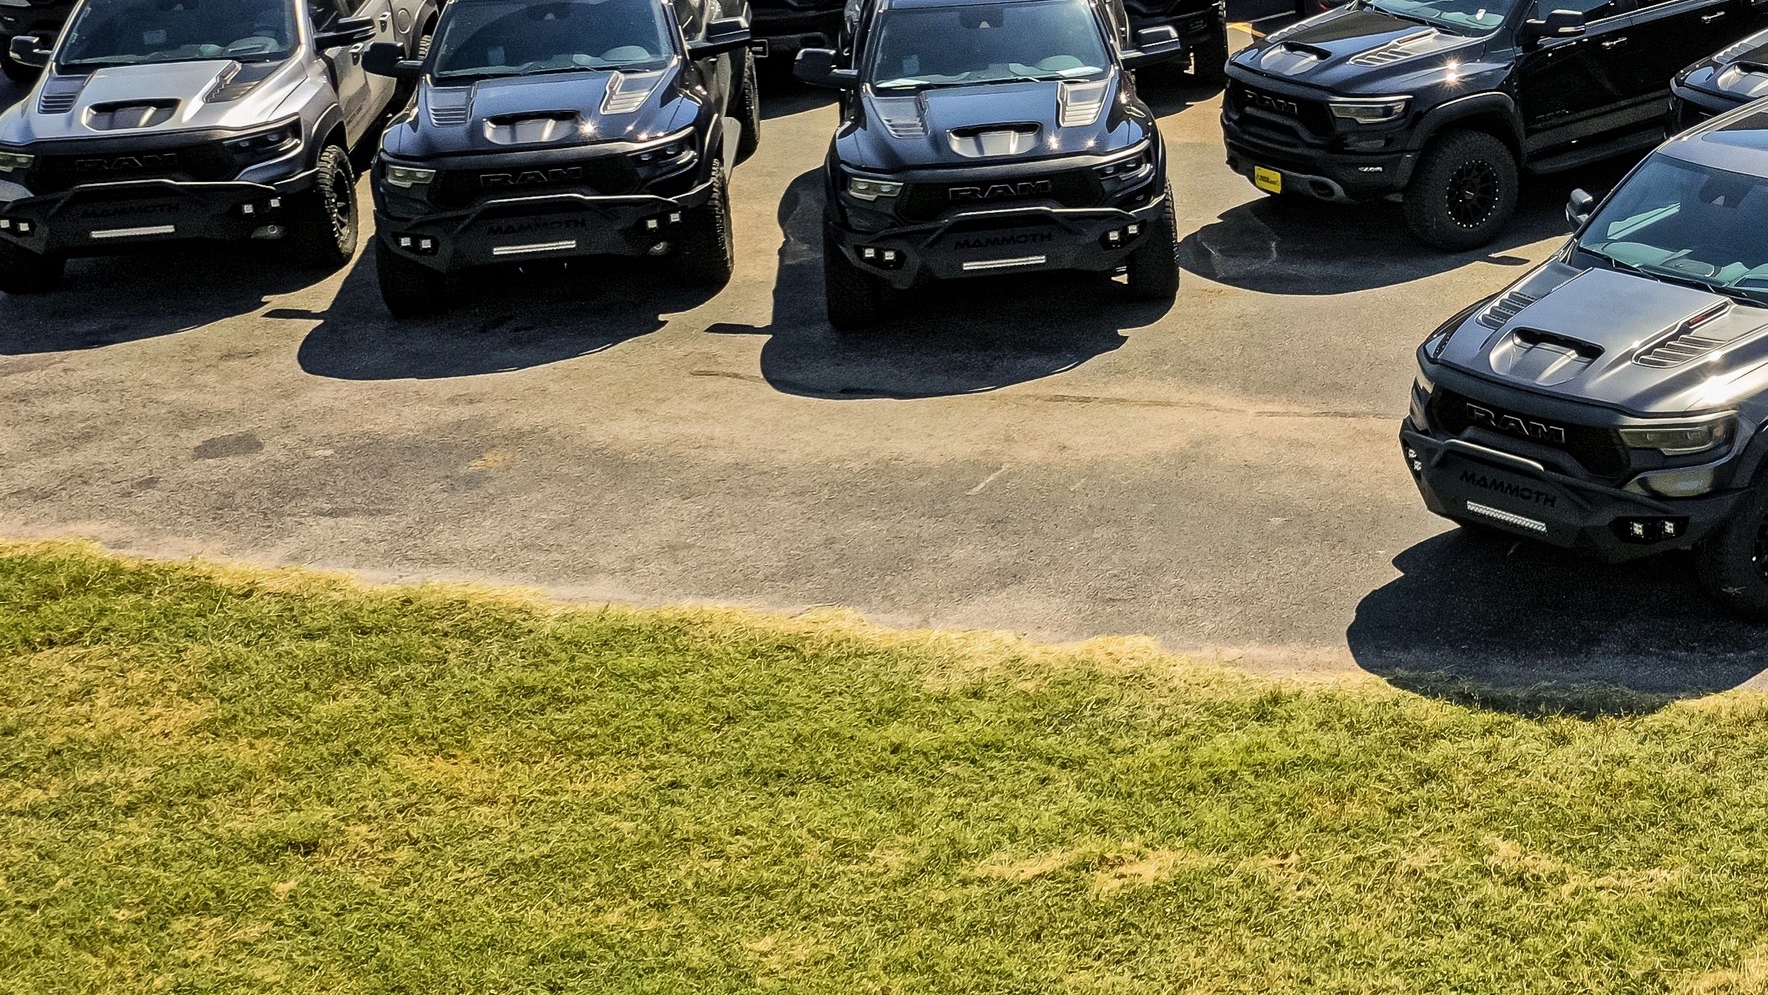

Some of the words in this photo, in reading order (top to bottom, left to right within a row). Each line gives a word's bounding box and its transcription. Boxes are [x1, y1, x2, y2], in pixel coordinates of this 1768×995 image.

[75, 152, 178, 172] RAM
[480, 166, 583, 187] RAM
[948, 179, 1053, 201] RAM
[954, 231, 1053, 250] MAMMOTH
[1465, 401, 1566, 444] RAM
[1460, 470, 1558, 508] MAMMOTH
